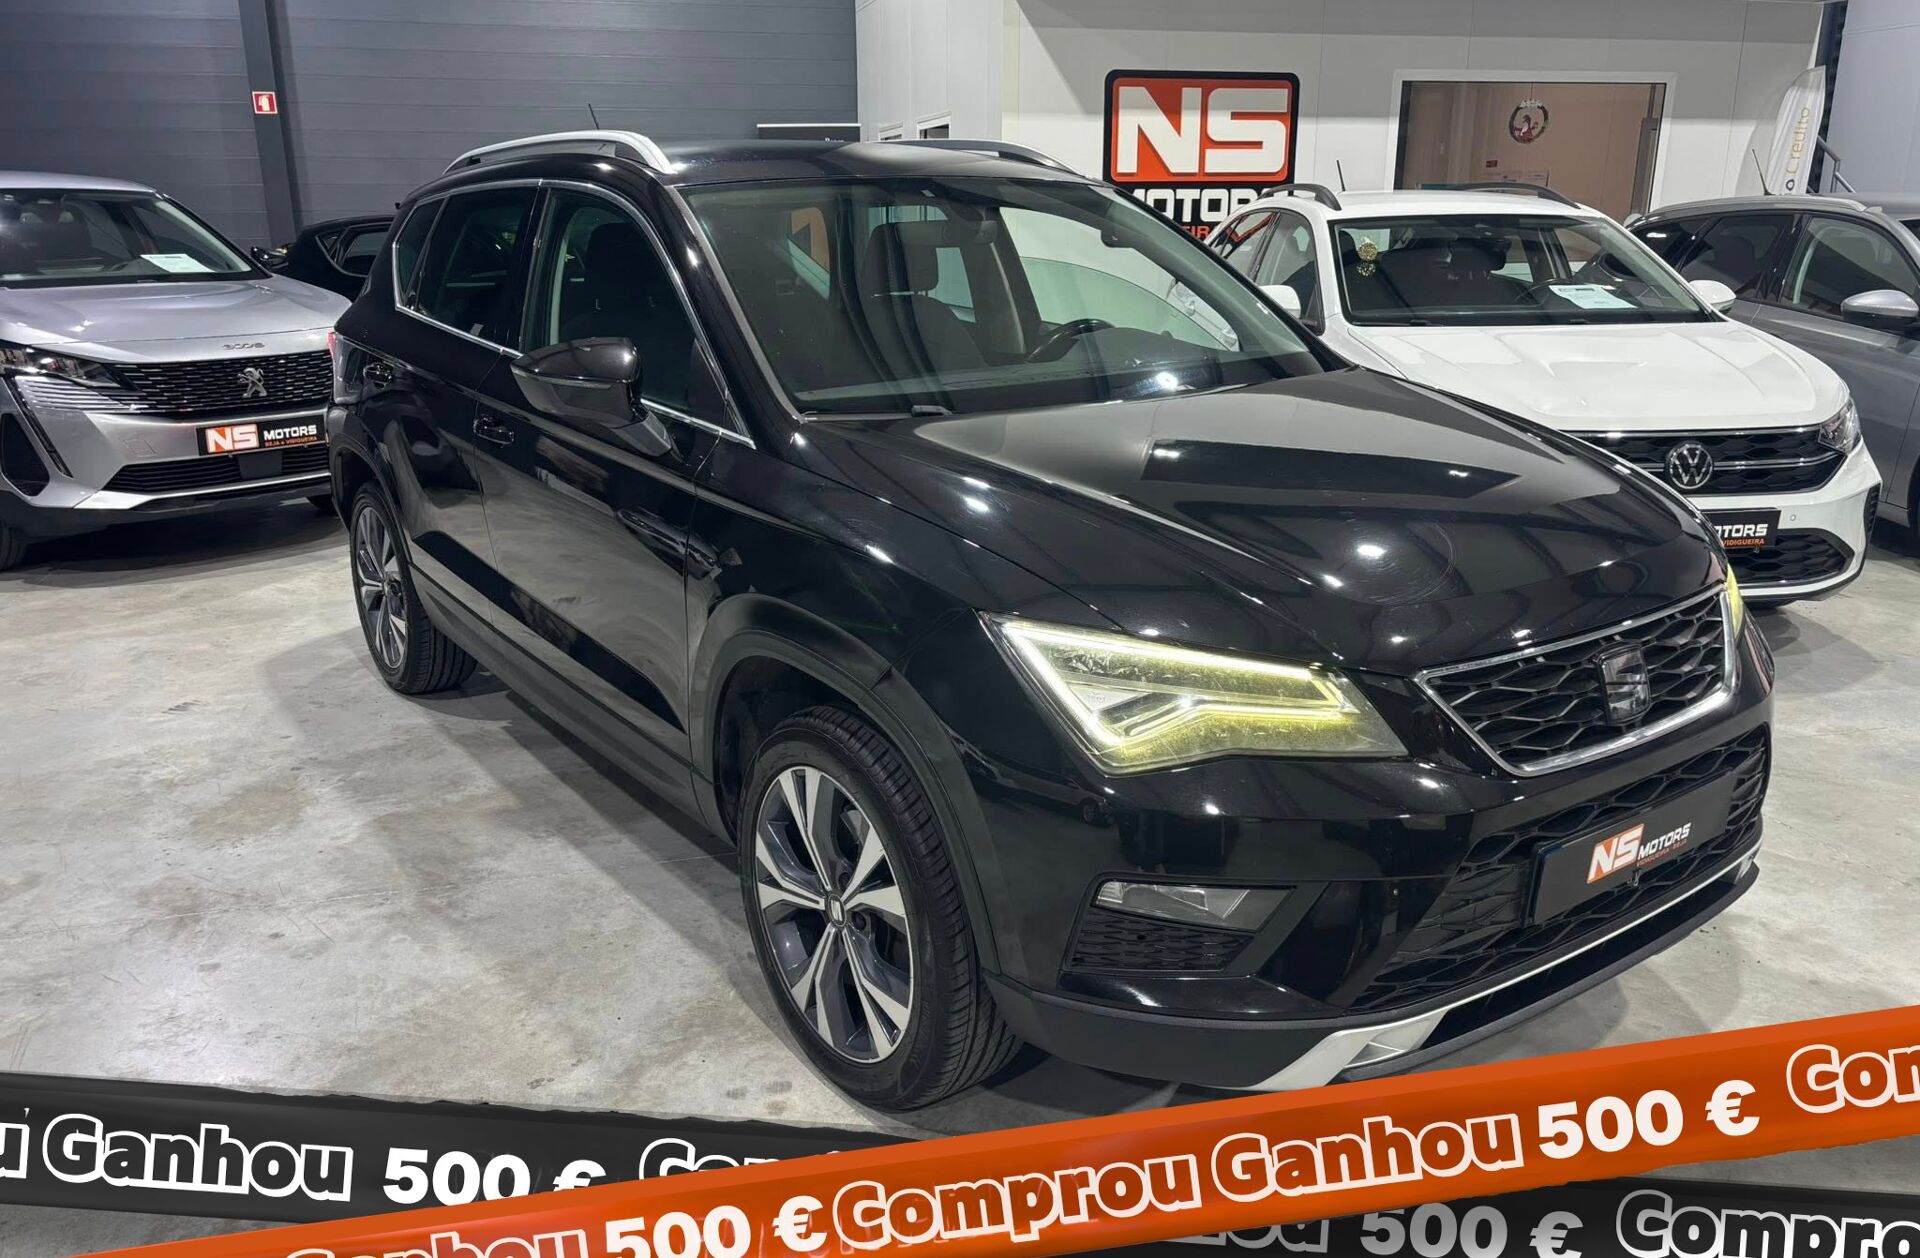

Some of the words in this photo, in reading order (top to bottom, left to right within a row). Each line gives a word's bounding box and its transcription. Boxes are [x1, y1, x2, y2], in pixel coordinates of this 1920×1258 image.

[1116, 86, 1288, 173] NS
[1133, 188, 1290, 222] OTOR
[206, 424, 259, 453] NS
[263, 425, 317, 441] MOTORS
[1713, 524, 1768, 539] OTORS
[1588, 824, 1644, 883] NS
[1637, 822, 1691, 861] MOTORS
